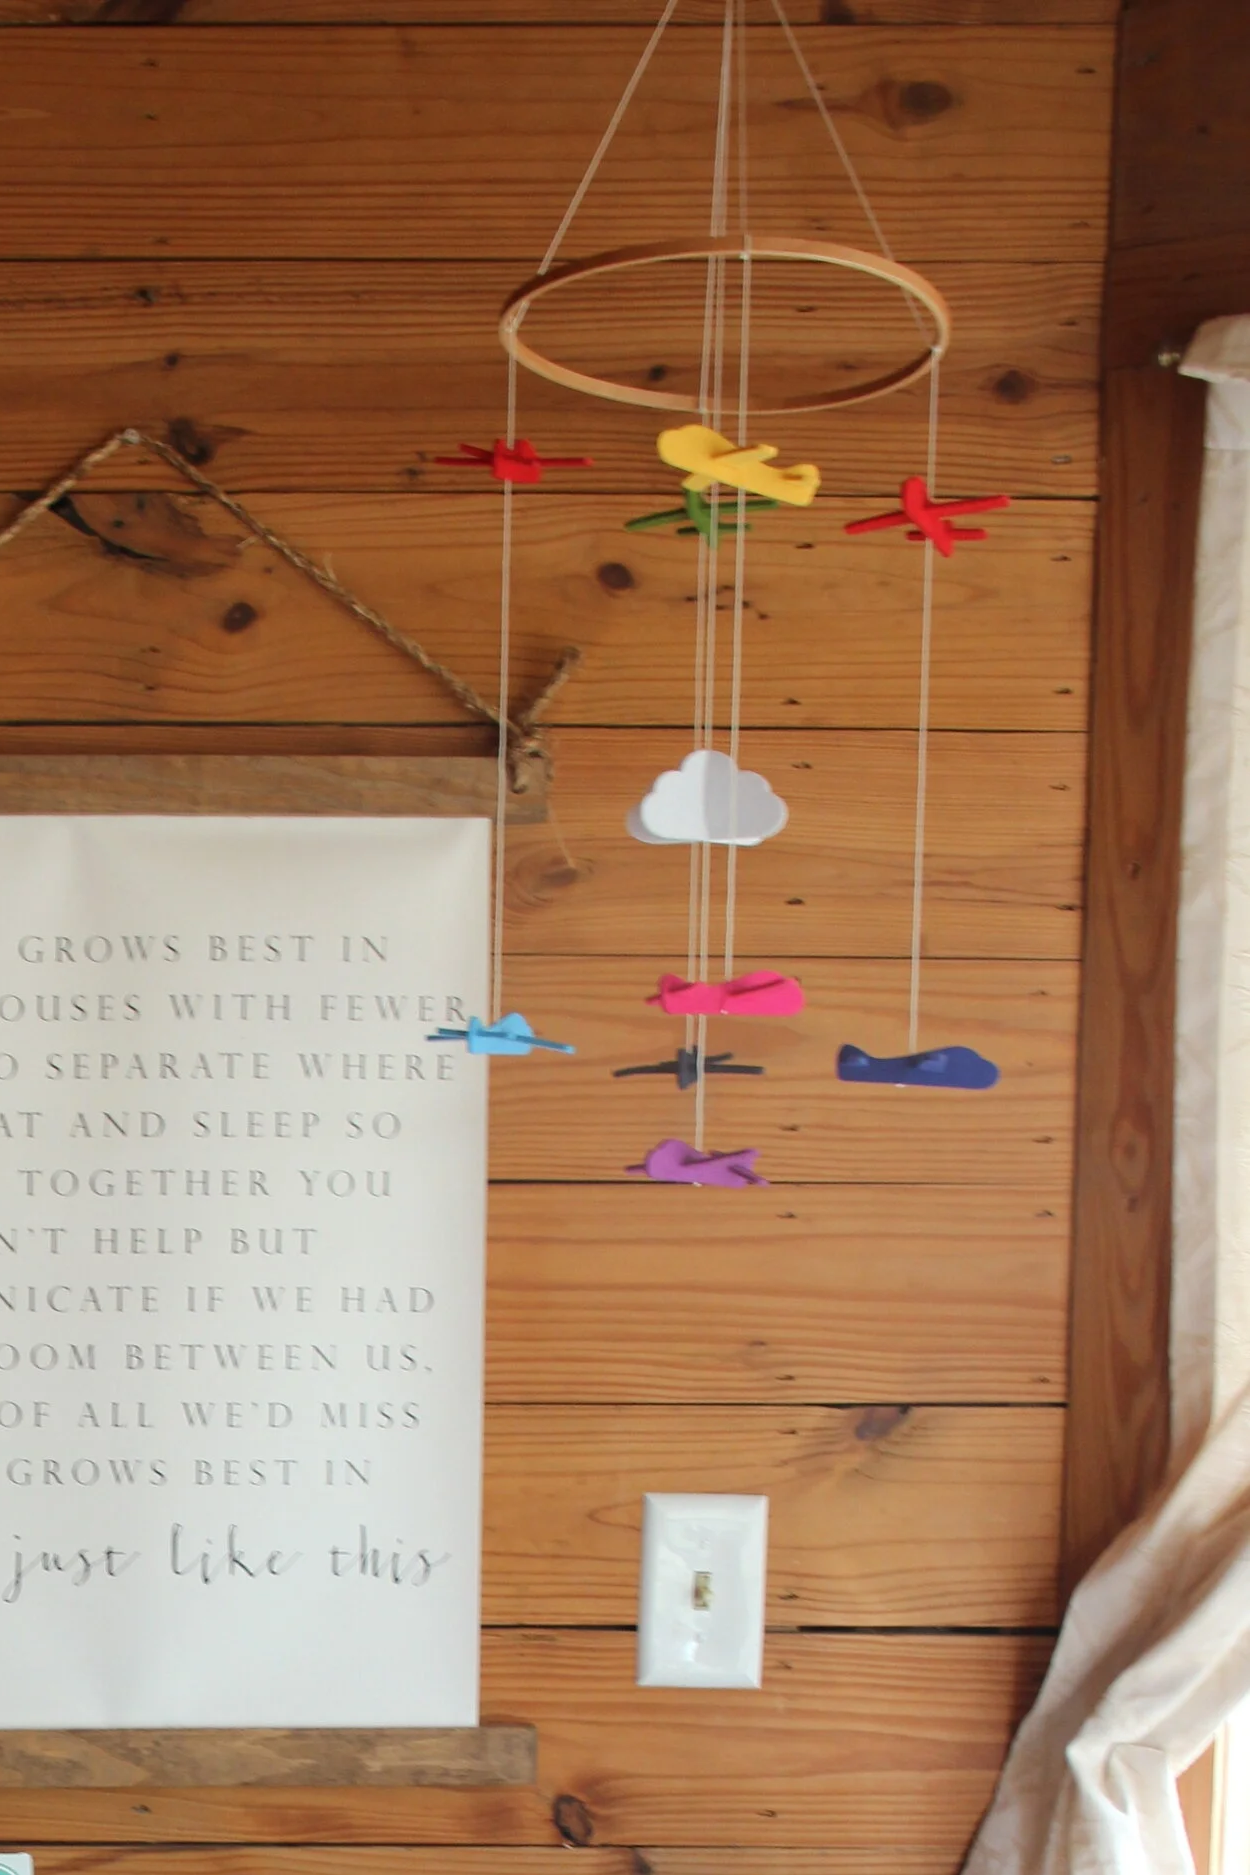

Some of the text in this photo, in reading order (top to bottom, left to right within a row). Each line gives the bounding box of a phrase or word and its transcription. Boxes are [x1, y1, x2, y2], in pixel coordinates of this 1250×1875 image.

[17, 934, 181, 964] GROWS
[208, 934, 315, 963] BEST
[342, 935, 387, 963] IN
[168, 993, 291, 1021] WITH
[320, 994, 466, 1022] FEWER
[45, 1052, 270, 1081] SEPARATE
[297, 1052, 453, 1081] WHERE
[69, 1111, 167, 1139] AND
[192, 1110, 321, 1138] SLEEP
[346, 1111, 402, 1140] SO
[17, 1168, 270, 1197] TOGETHER
[298, 1169, 391, 1198] YOU
[93, 1227, 203, 1255] HELP
[230, 1227, 318, 1256] BUT
[187, 1285, 224, 1313] IF
[251, 1286, 312, 1313] WE
[340, 1286, 435, 1314] HAD
[125, 1343, 337, 1371] BETWEEN
[77, 1401, 154, 1429] ALL
[180, 1401, 293, 1429] WE'D
[321, 1401, 420, 1429] MISS
[5, 1458, 168, 1487] GROWS
[194, 1459, 299, 1487] BEST
[325, 1459, 371, 1486] IN
[1, 1534, 140, 1604] just
[169, 1521, 303, 1586] like
[327, 1523, 451, 1588] this
